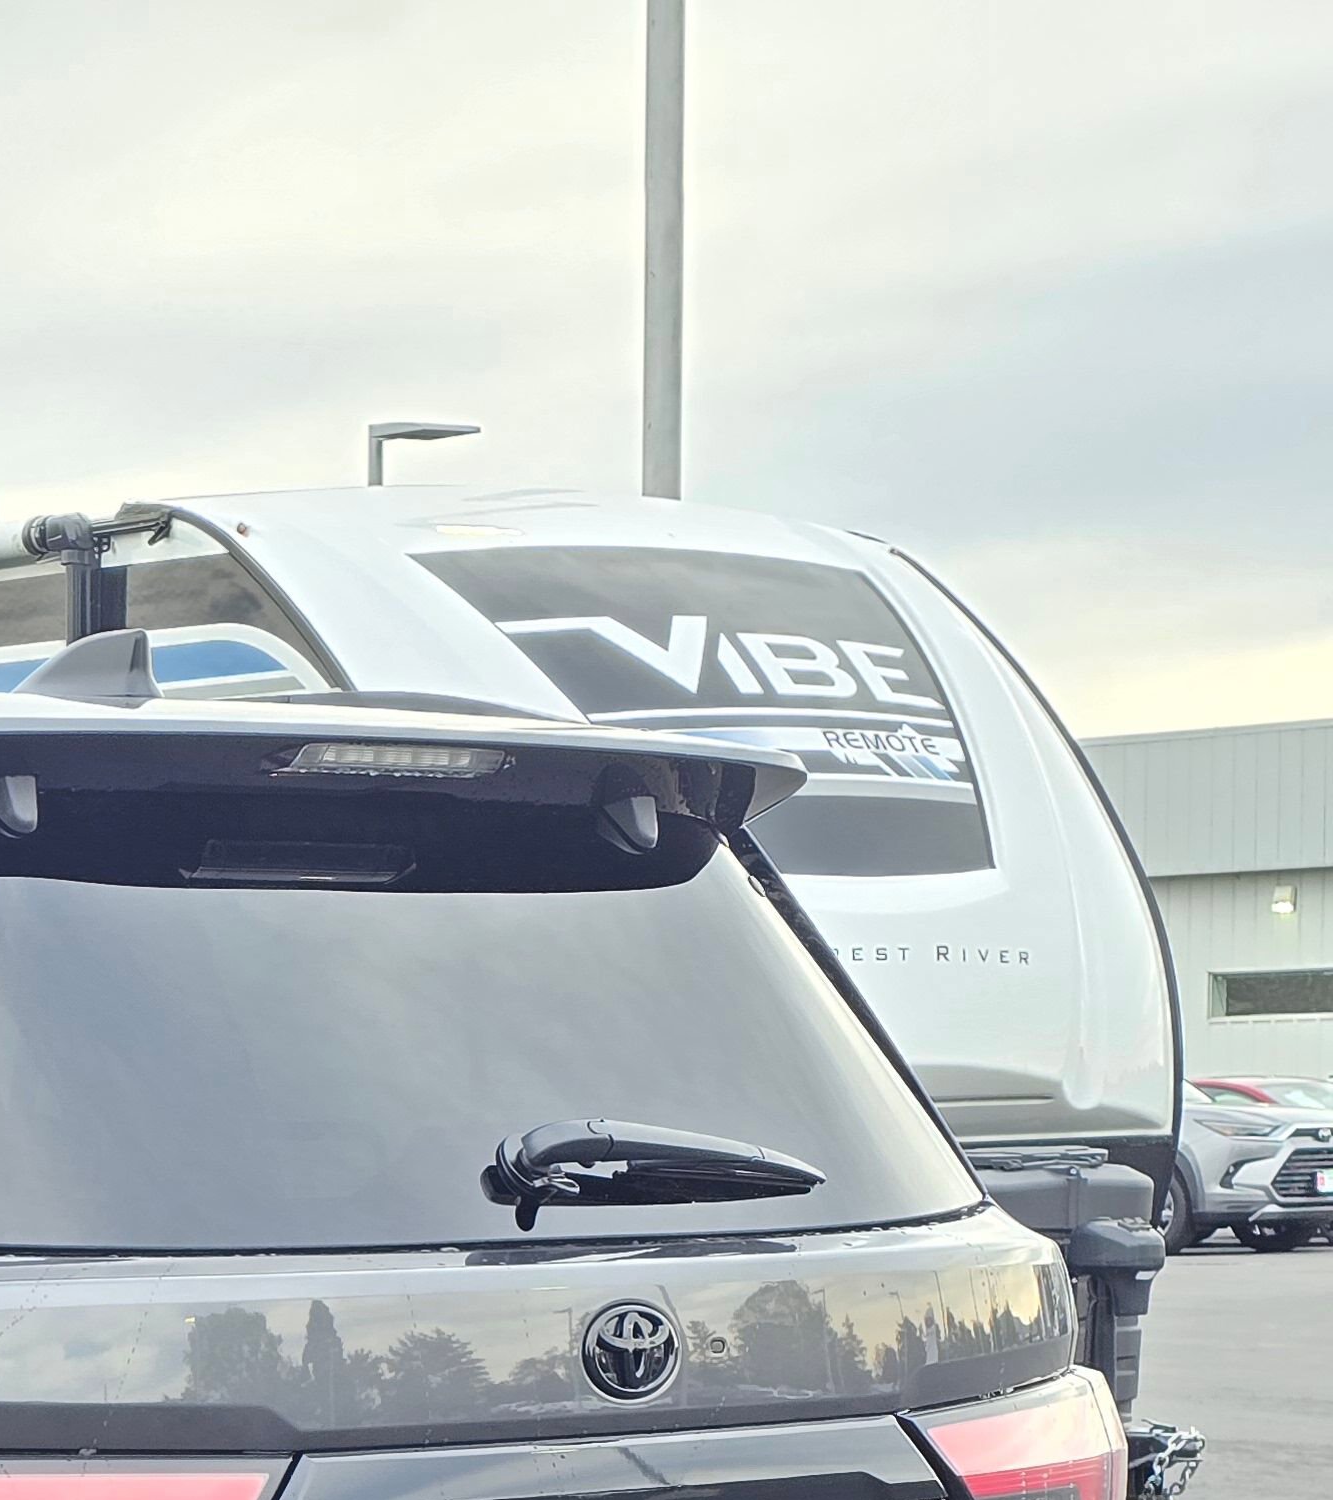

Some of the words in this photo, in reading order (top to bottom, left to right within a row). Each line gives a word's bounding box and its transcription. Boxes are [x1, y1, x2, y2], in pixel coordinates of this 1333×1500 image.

[495, 615, 945, 710] VIBE
[822, 729, 941, 756] REMOTE
[833, 946, 910, 961] EST
[936, 945, 1030, 965] RIVER
